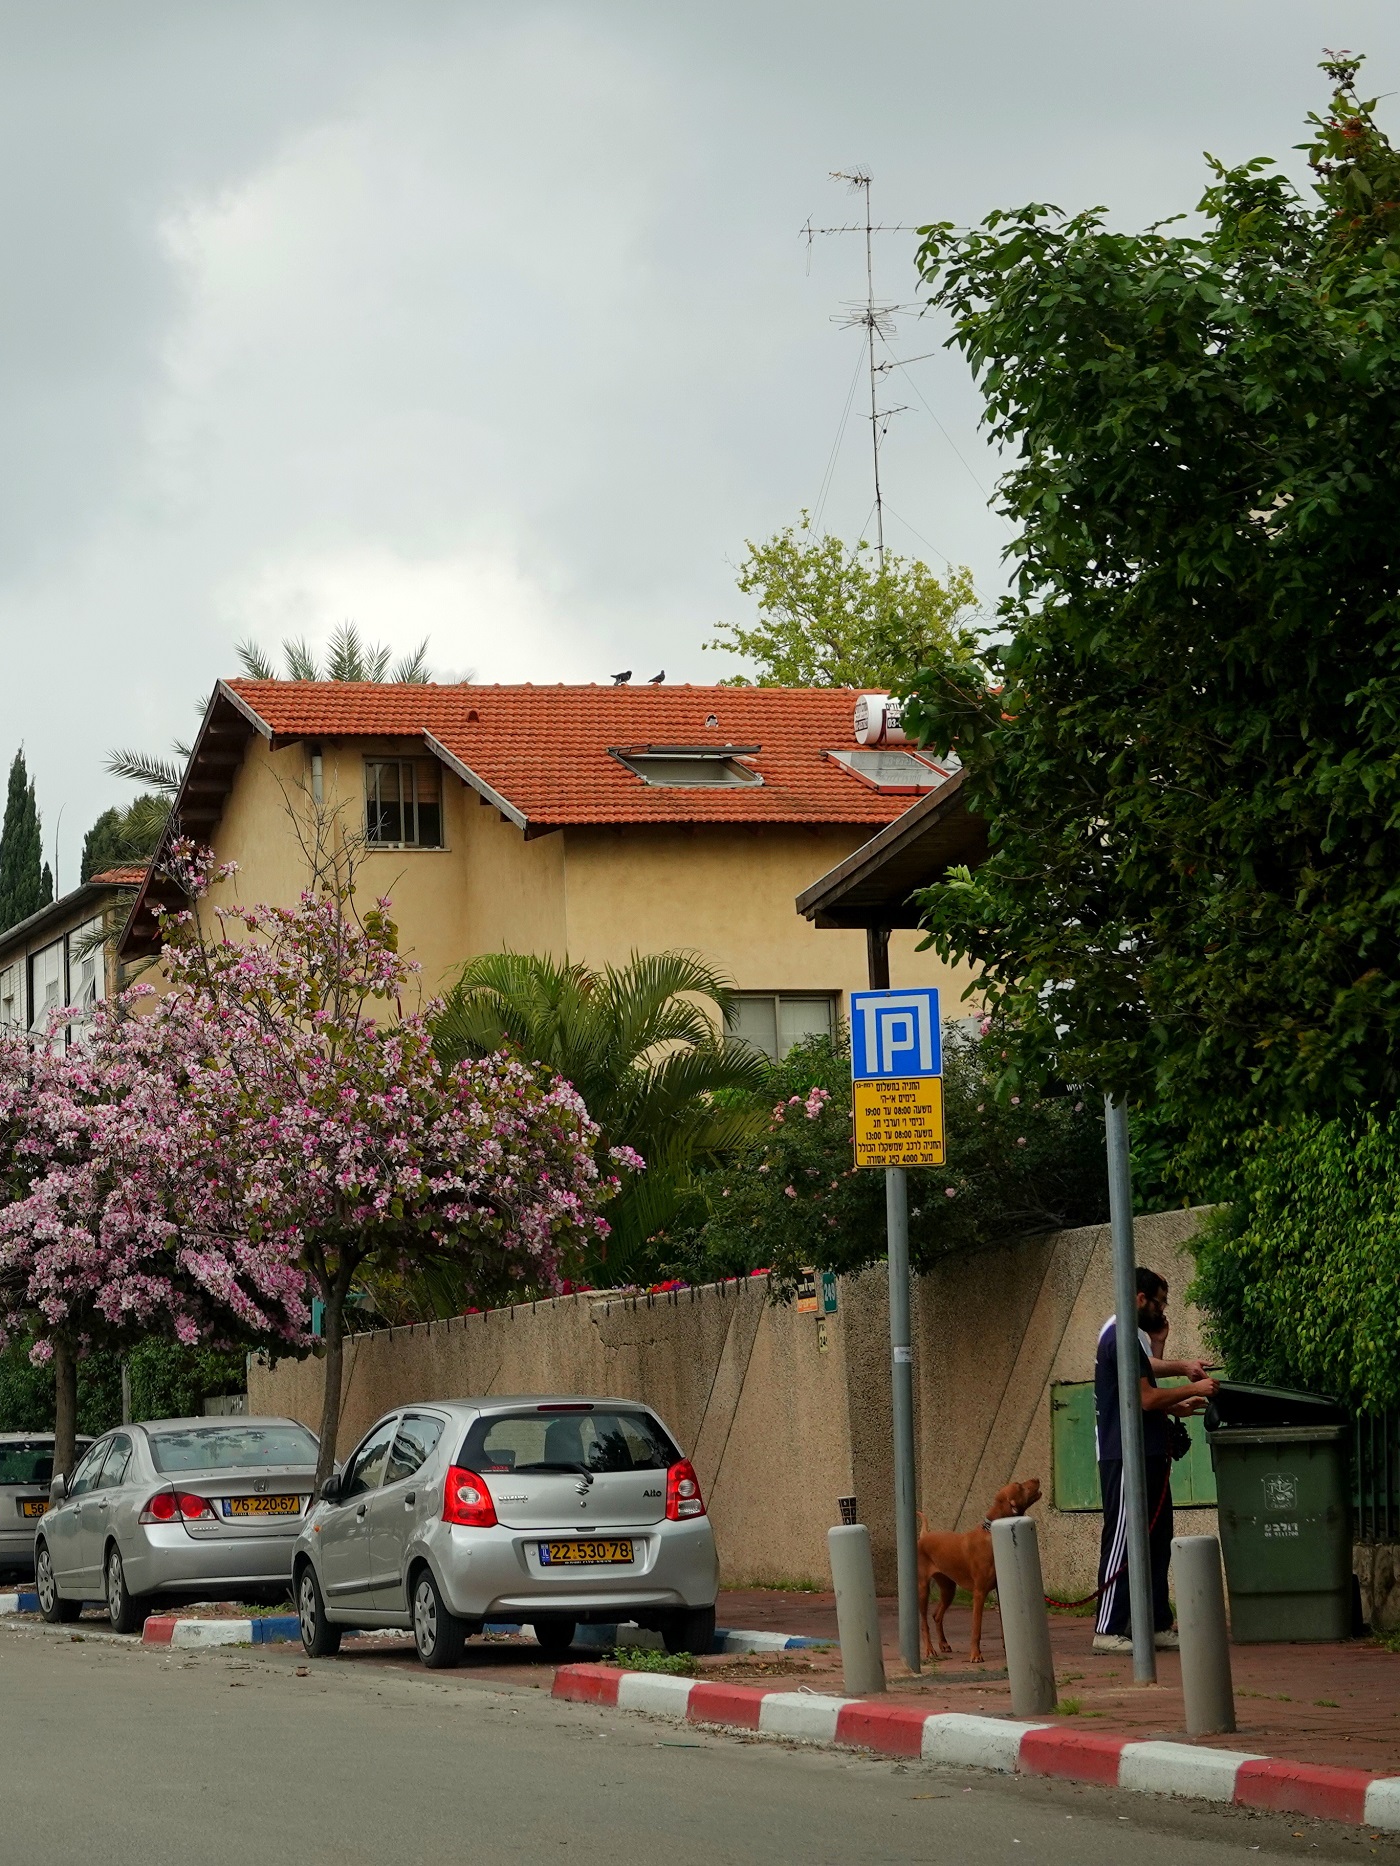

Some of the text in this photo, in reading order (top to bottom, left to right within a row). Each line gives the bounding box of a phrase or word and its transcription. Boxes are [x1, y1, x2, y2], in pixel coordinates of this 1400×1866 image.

[876, 1082, 920, 1092] החניה בתשלום
[899, 1094, 916, 1102] בימים
[865, 1105, 932, 1116] משעה 08:00 עד 19:00
[866, 1129, 932, 1140] משעה 08:00 עד 13:00
[858, 1141, 941, 1152] החניה לרכב שמשקלו הכולל
[867, 1156, 886, 1164] אסורה
[920, 1153, 933, 1161] מעל
